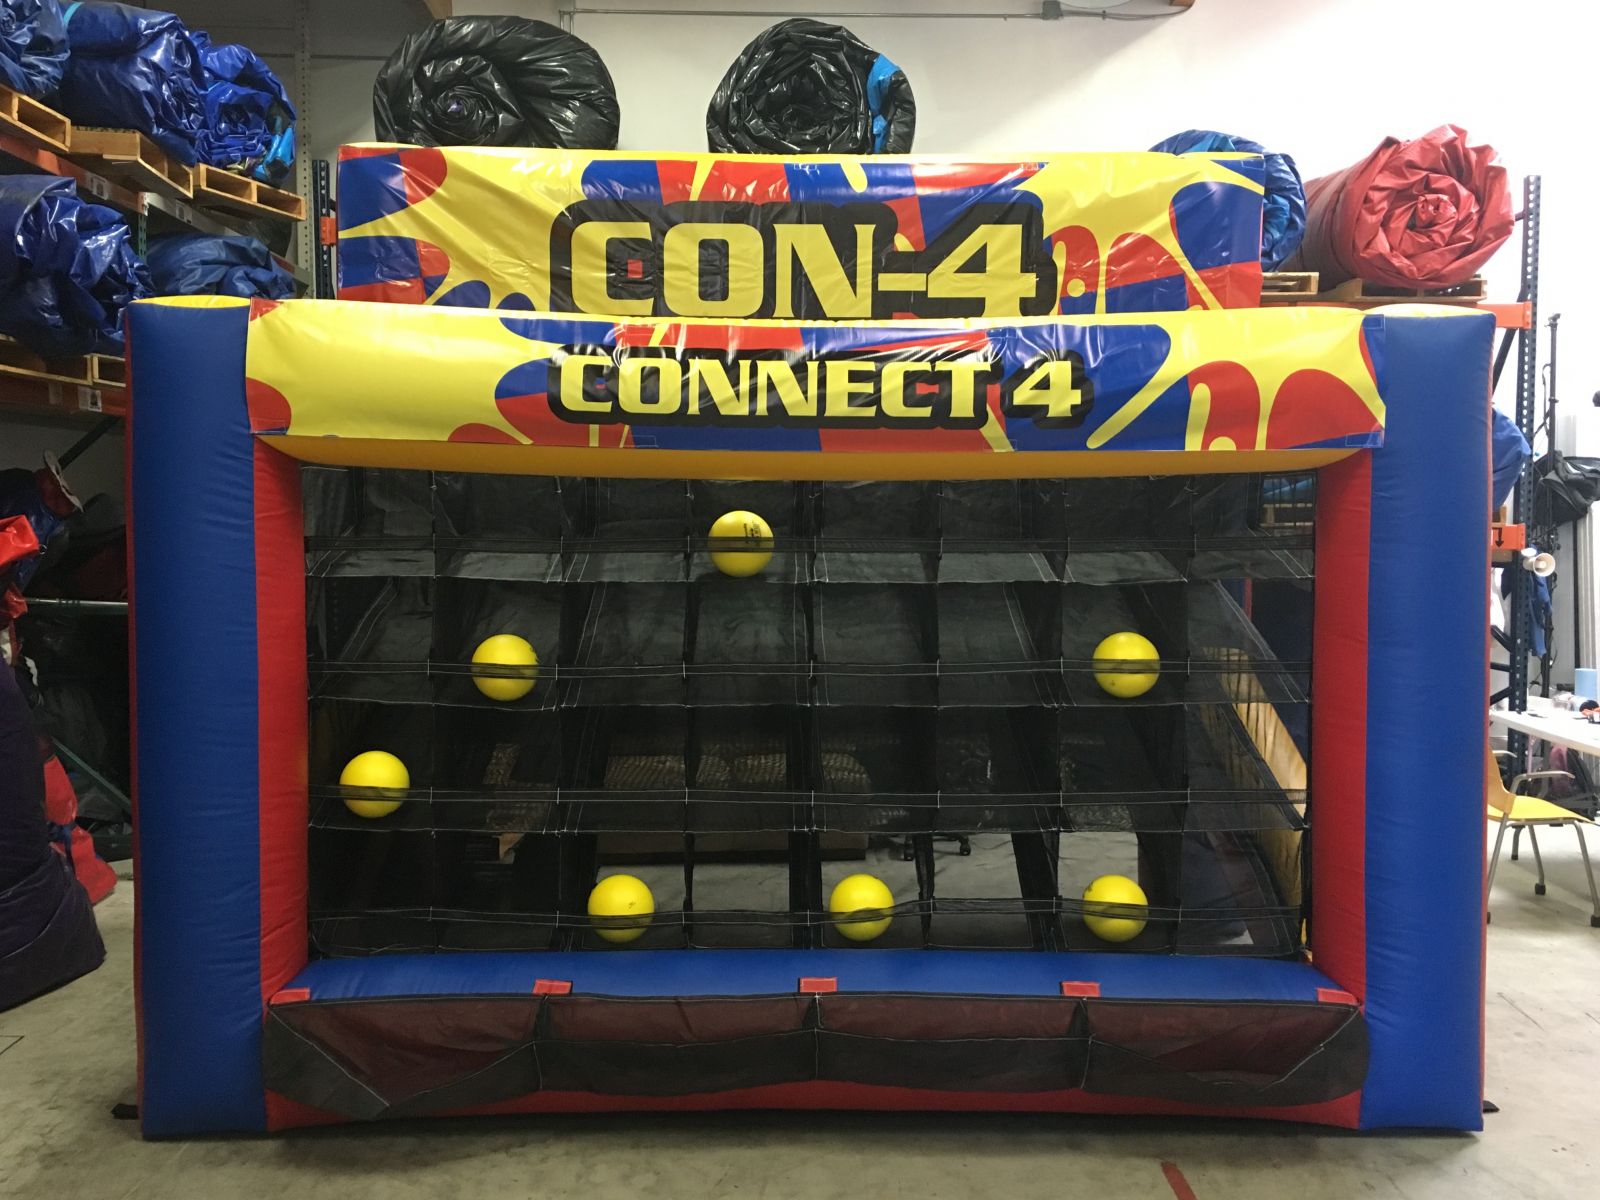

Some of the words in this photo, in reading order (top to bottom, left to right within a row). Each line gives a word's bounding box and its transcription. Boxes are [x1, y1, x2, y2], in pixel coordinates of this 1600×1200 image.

[571, 221, 1037, 318] CON-4
[560, 355, 991, 418] CONNECT
[1013, 361, 1081, 417] 4
